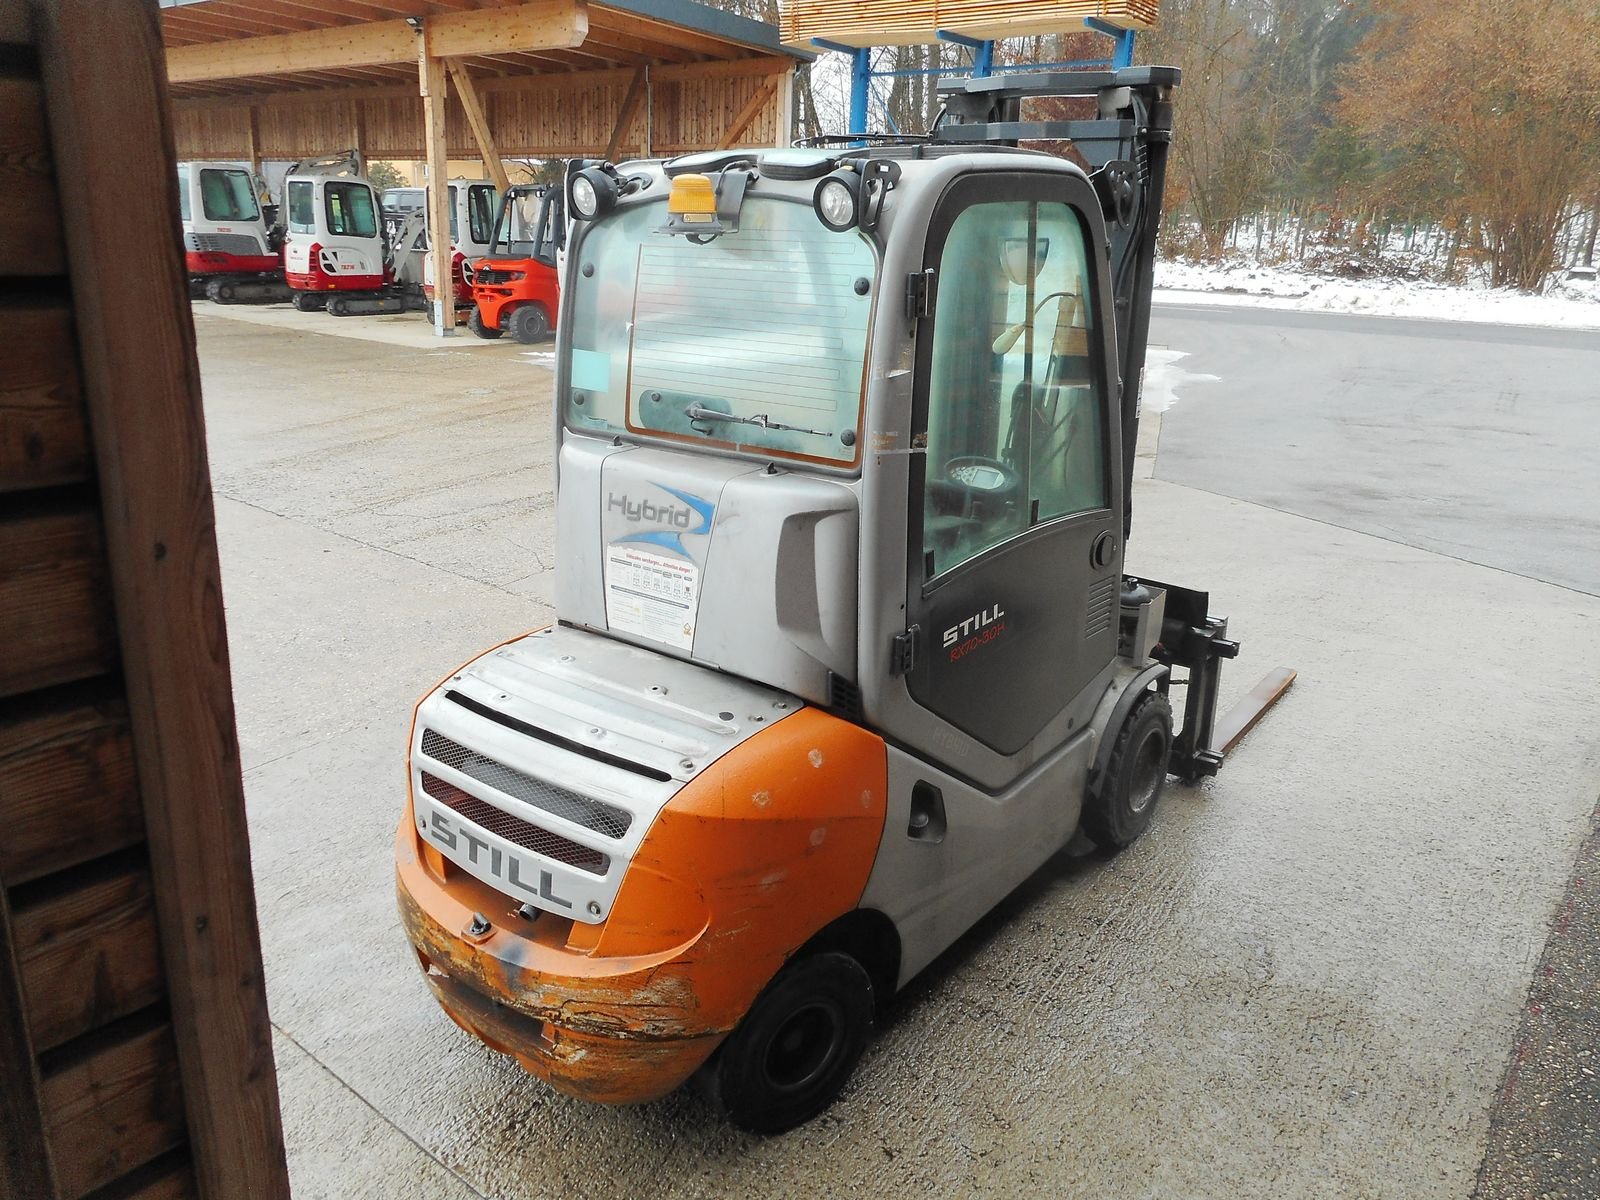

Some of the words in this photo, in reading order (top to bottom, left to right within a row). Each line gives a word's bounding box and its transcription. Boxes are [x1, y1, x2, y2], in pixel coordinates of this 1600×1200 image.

[607, 492, 691, 529] Hybrid
[943, 603, 1005, 648] STILL
[431, 810, 573, 909] STILL
